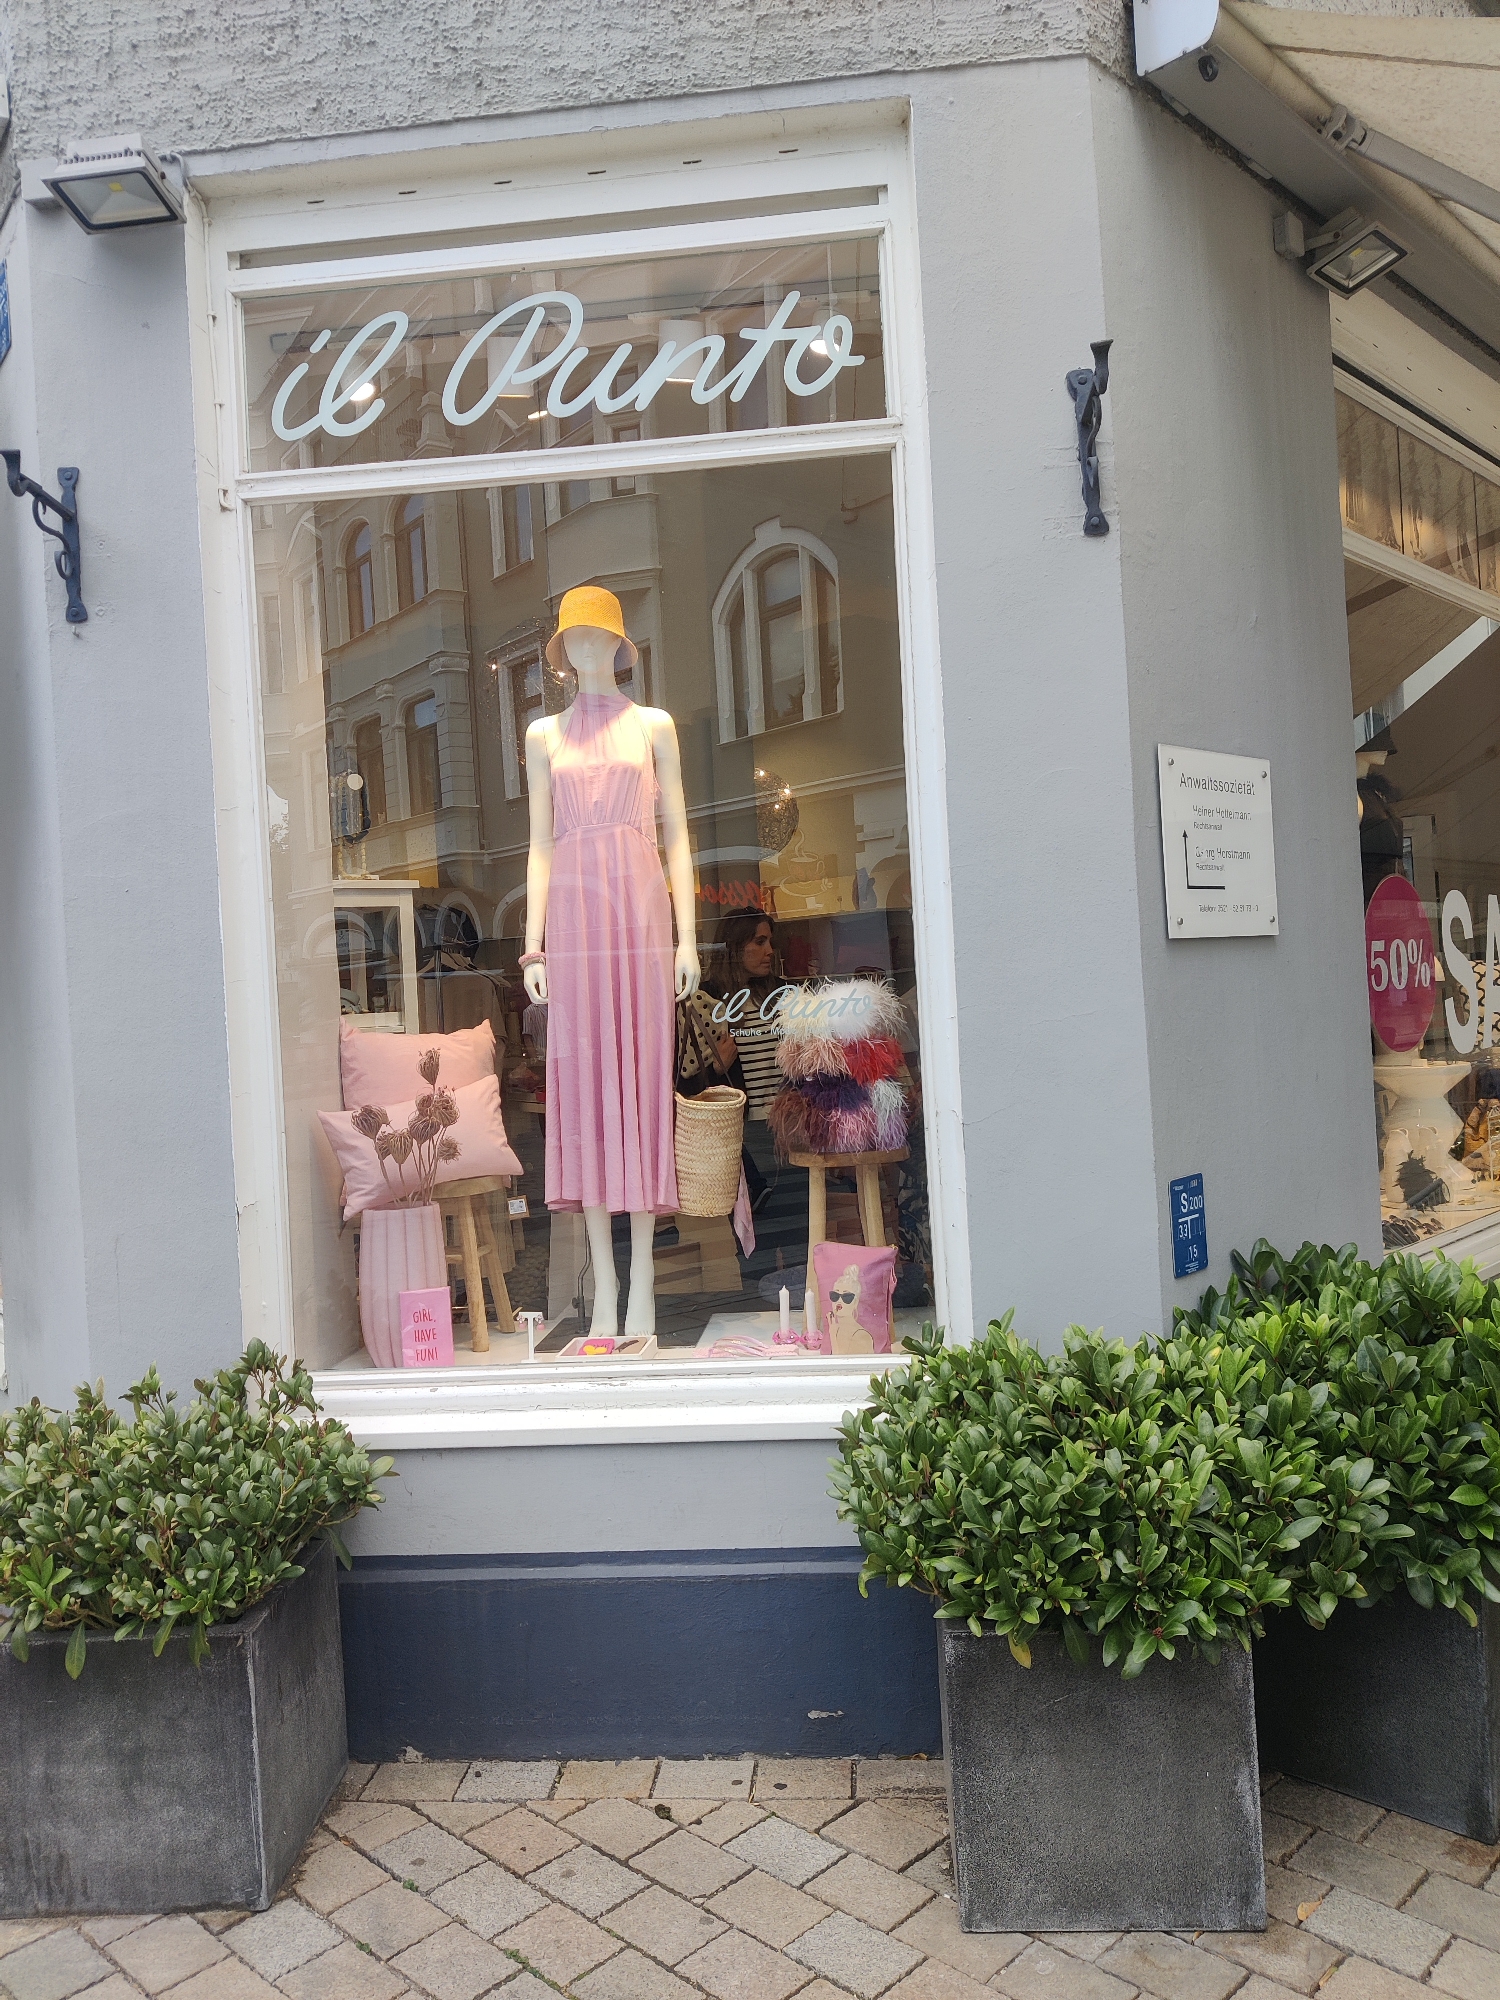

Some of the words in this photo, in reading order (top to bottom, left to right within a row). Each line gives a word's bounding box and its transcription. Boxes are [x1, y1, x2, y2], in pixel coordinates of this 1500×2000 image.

[271, 310, 408, 441] il
[441, 290, 865, 427] Punto
[1179, 772, 1256, 796] Anwaltssozietät
[1371, 938, 1431, 992] 50%
[711, 988, 751, 1024] il
[759, 984, 875, 1022] Punto
[729, 1027, 762, 1038] Schuhe
[1189, 1195, 1203, 1211] 200
[414, 1327, 438, 1343] HAVE
